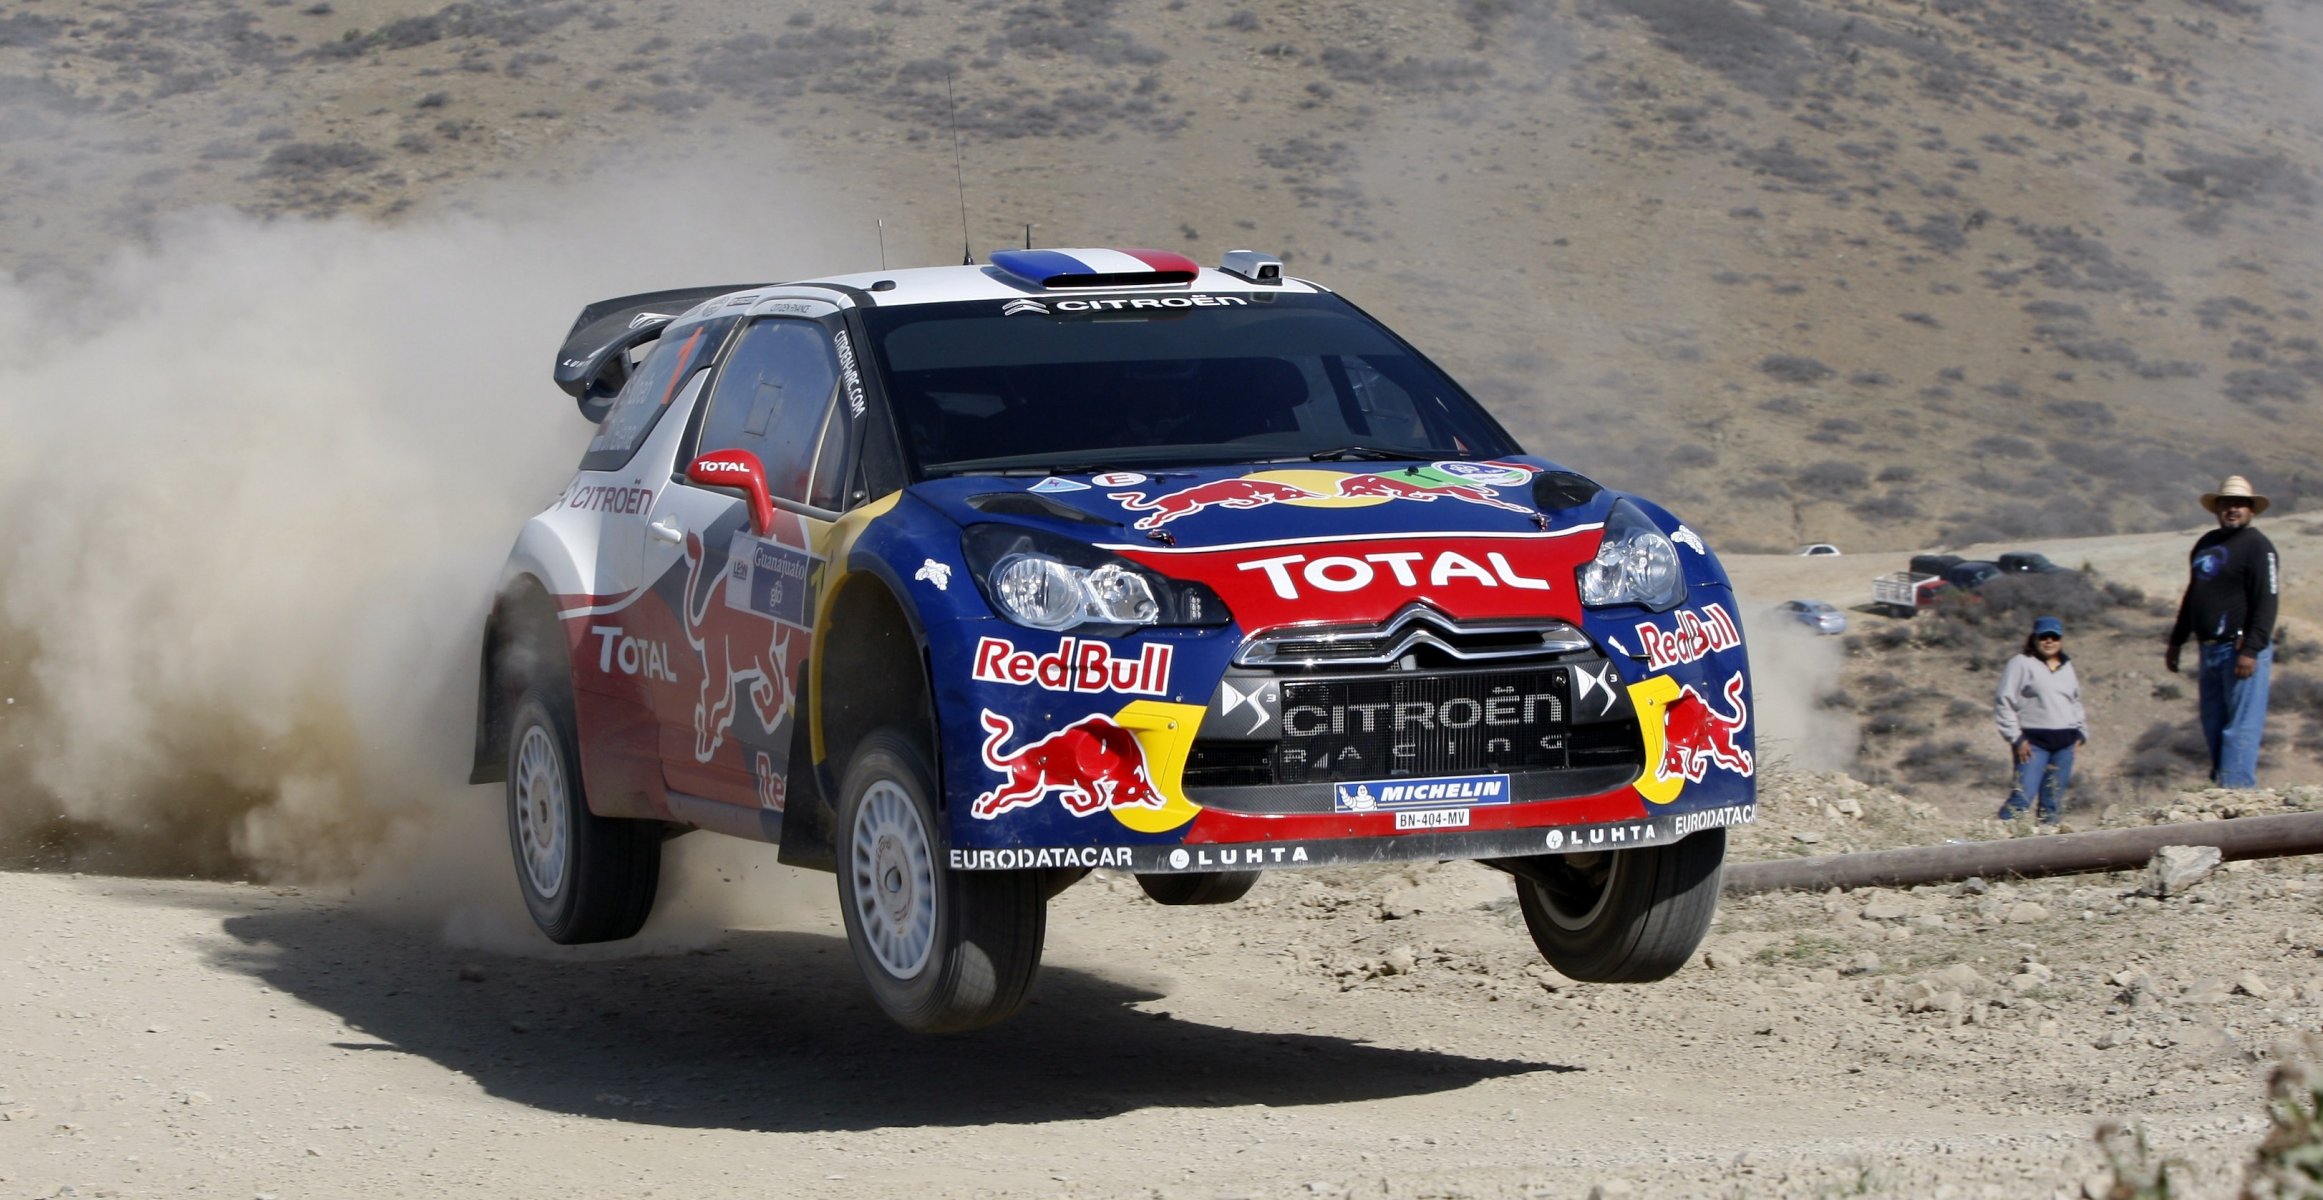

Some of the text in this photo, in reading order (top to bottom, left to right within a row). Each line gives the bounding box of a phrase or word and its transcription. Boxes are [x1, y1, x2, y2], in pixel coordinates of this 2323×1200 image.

[1056, 294, 1248, 312] CITROËN
[698, 460, 751, 473] TOTAL
[570, 479, 654, 516] CITROËN
[753, 546, 805, 580] Guanajuato
[1236, 551, 1551, 600] TOTAL
[1638, 606, 1739, 668] Red Bull
[591, 625, 678, 682] TOTAL
[974, 638, 1170, 693] Red Bull
[1282, 686, 1562, 737] CITROËN
[1380, 781, 1502, 802] MICHELIN
[1400, 811, 1465, 828] BN-404-MV
[1570, 824, 1656, 845] LUHTA
[950, 847, 1133, 869] EURODATACAR
[1198, 846, 1309, 865] LUHTA
